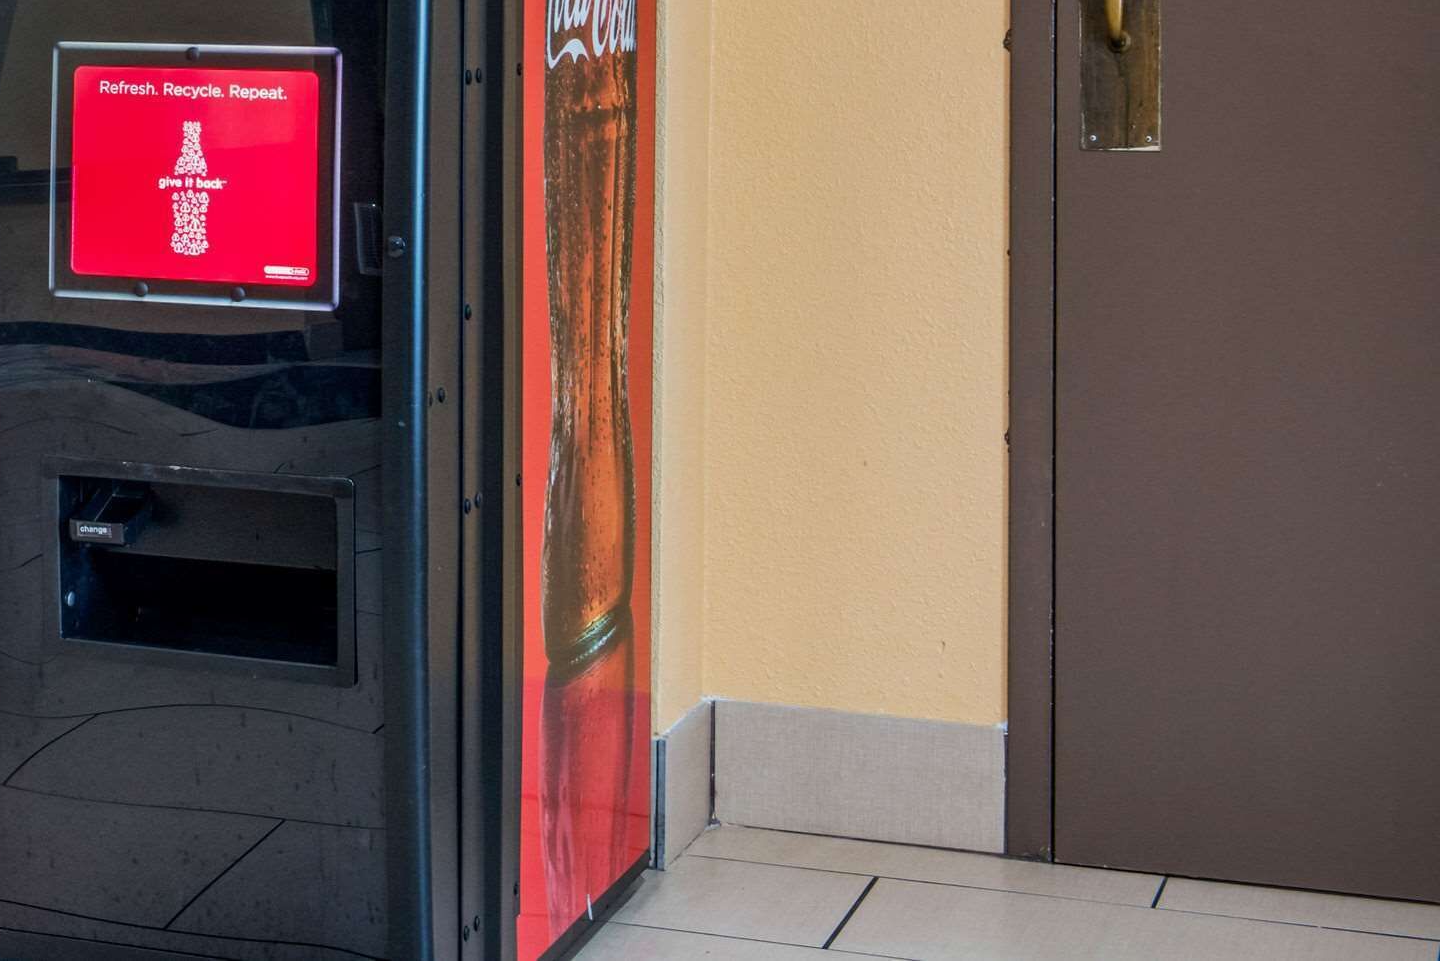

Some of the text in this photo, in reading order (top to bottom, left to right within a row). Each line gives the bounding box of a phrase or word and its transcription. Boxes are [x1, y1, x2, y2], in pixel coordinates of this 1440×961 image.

[100, 80, 288, 101] Refresh. Recycle. Repeat.
[158, 176, 223, 190] give it back
[80, 524, 108, 534] change
